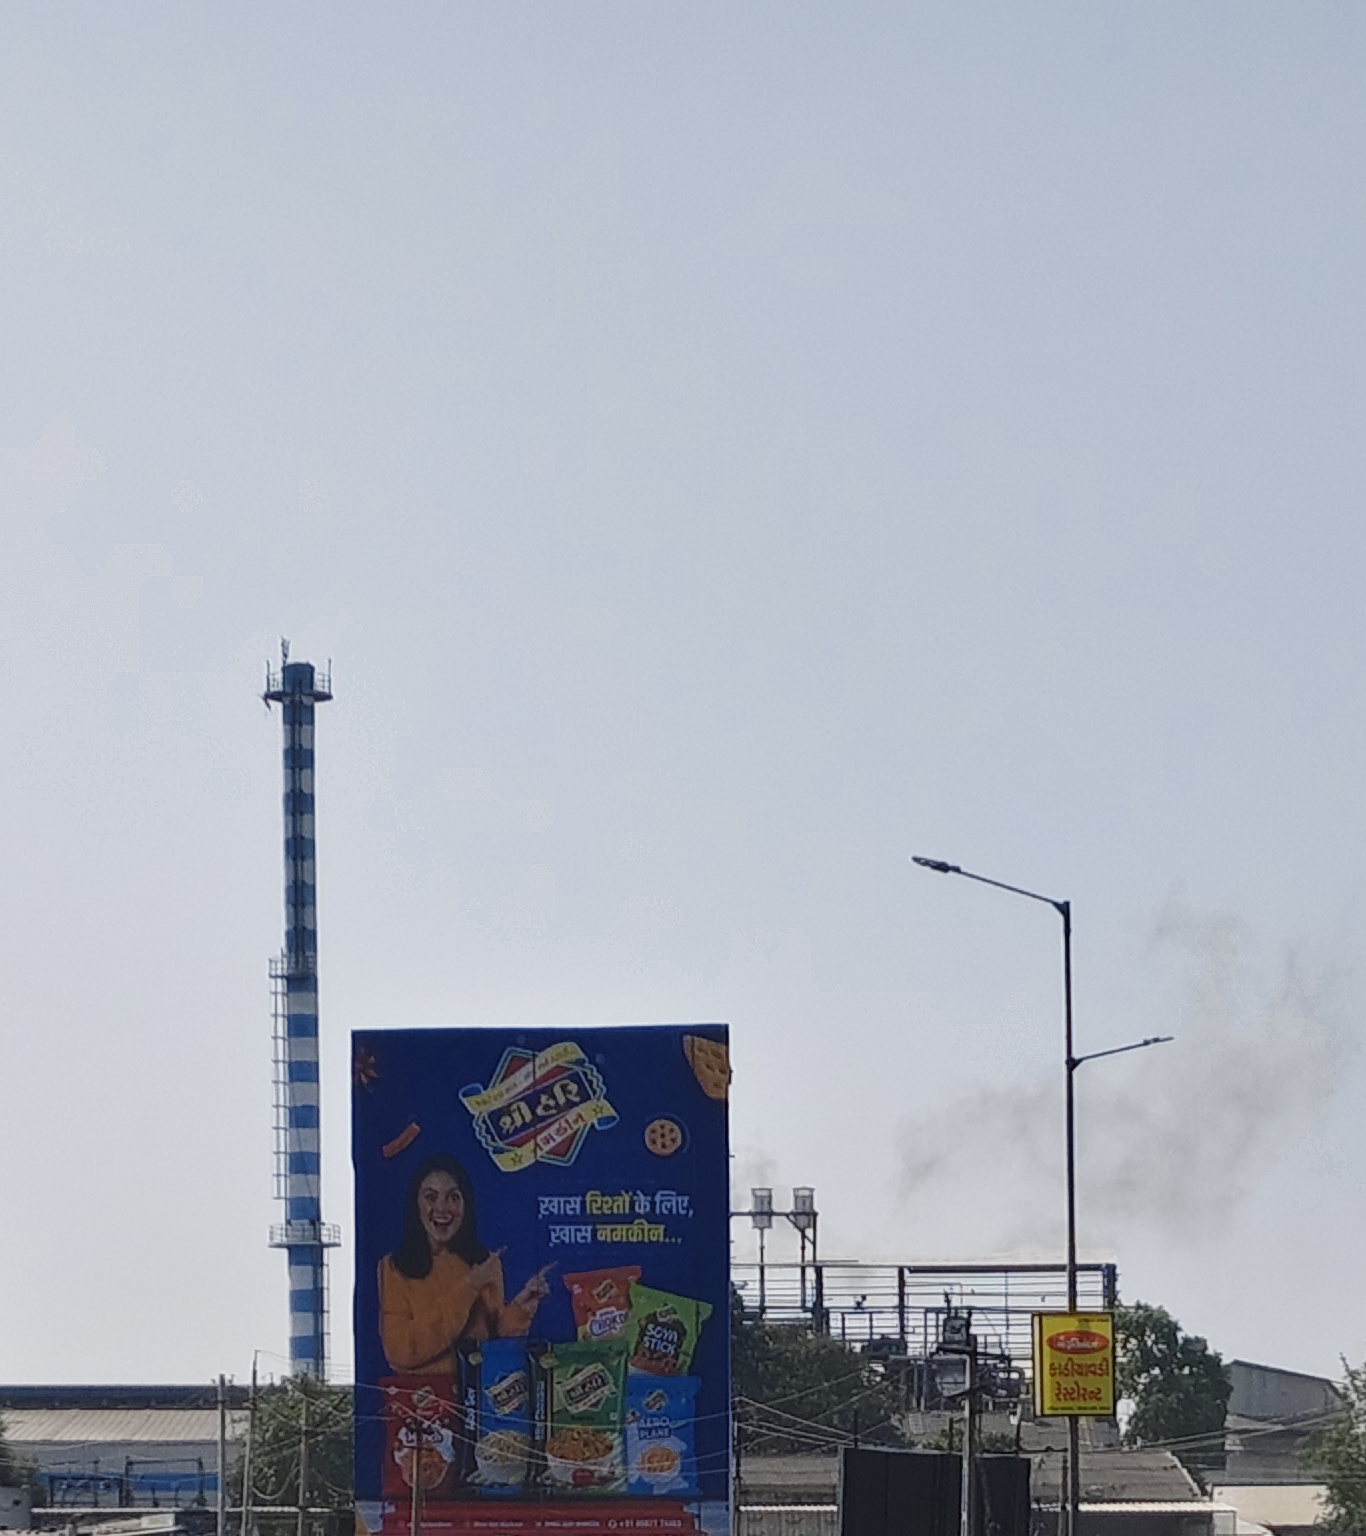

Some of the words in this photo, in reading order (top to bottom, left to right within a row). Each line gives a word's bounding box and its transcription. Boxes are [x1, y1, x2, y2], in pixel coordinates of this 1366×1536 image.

[537, 1196, 582, 1219] ख़ास
[586, 1190, 633, 1214] रिश्तों
[633, 1190, 651, 1216] के
[652, 1190, 694, 1218] लिए,
[549, 1225, 593, 1247] ख़ास
[643, 1336, 676, 1355] STICK
